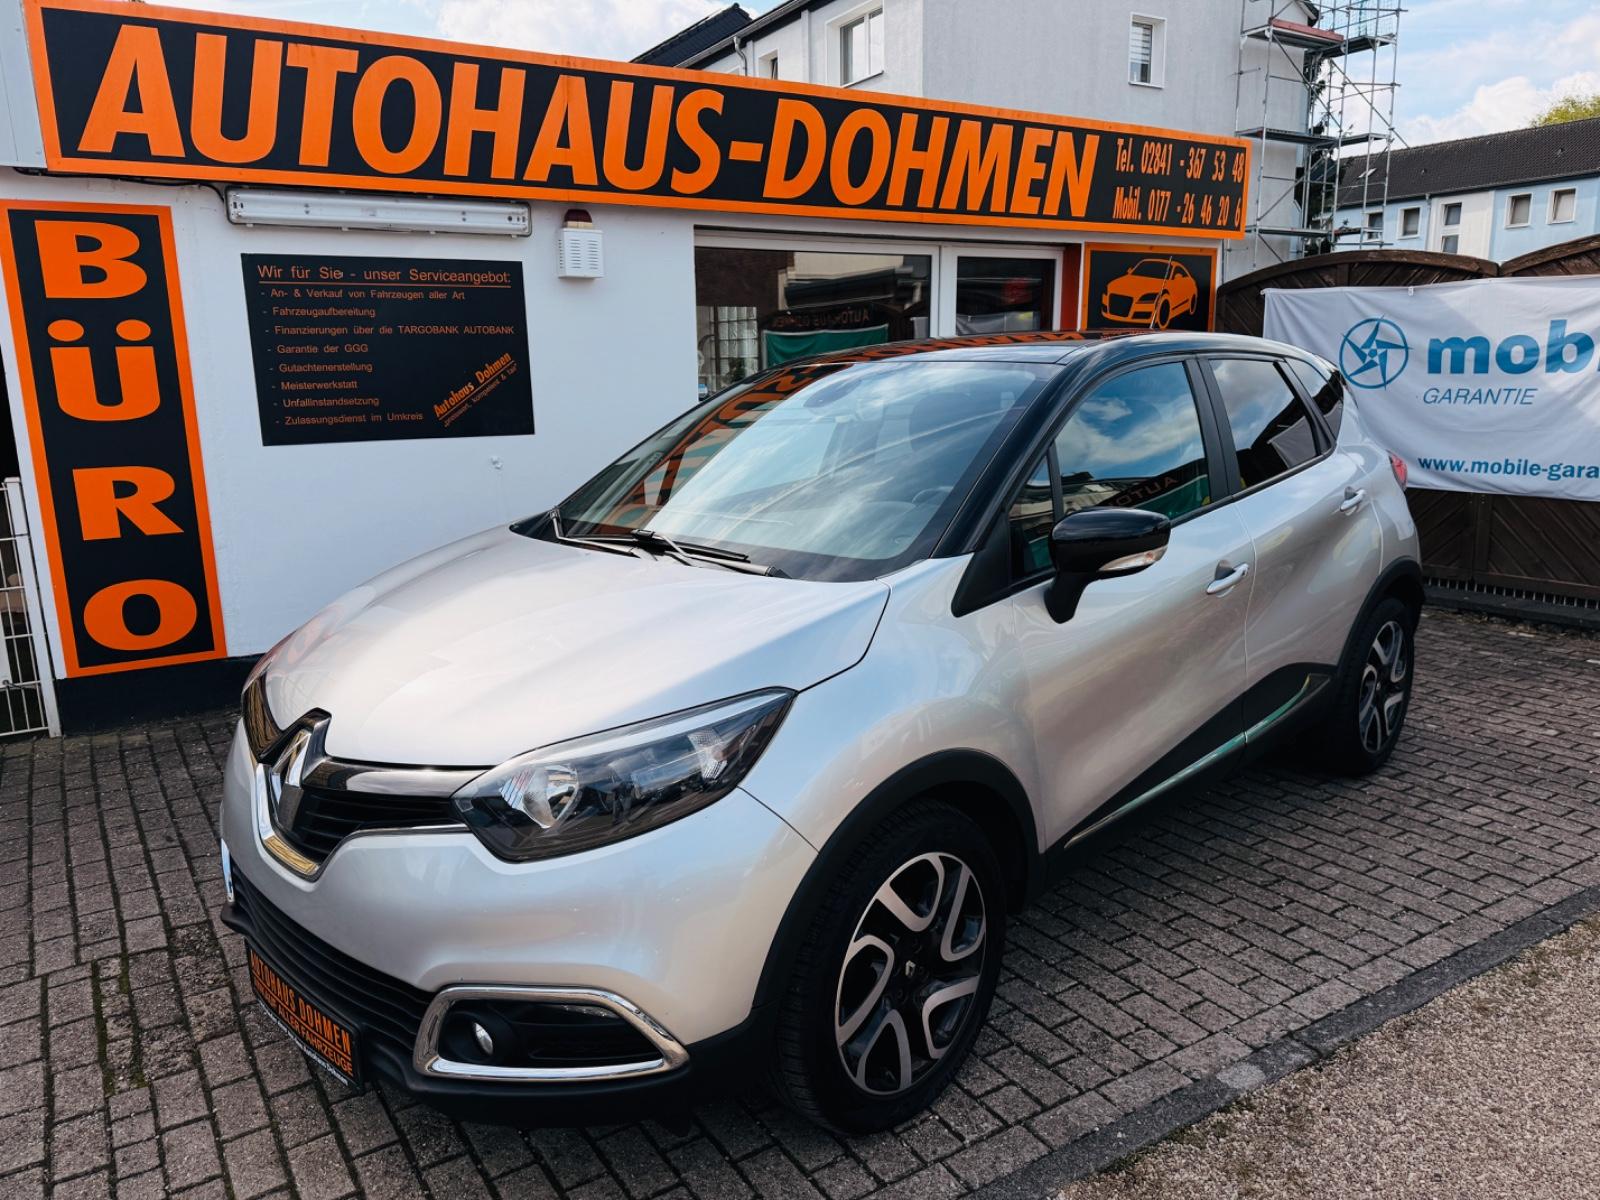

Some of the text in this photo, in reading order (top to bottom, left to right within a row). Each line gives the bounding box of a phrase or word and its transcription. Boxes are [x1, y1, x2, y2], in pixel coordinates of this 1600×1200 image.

[1115, 137, 1135, 173] Tel.
[1141, 140, 1173, 176] 02841
[1211, 150, 1226, 182] 53
[1232, 152, 1245, 183] 48
[1112, 186, 1142, 220] Mobil.
[1147, 188, 1172, 222] 0177
[1200, 194, 1212, 225] 46
[1216, 195, 1230, 226] 20
[1234, 197, 1242, 228] 6
[257, 263, 283, 279] Wir
[291, 265, 311, 279] für
[319, 266, 344, 280] Sie
[363, 268, 401, 281] unser
[409, 268, 512, 286] Serviceangebot:
[270, 288, 466, 301] An- & Verkauf von Fahrzeugen aller Art
[272, 306, 377, 318] Fahrzeugaufbereitung
[274, 325, 515, 337] Finanzierungen über die TARGOBANK AUTOBANK
[276, 343, 370, 354] Garantie der GGG
[1428, 318, 1600, 375] mob
[278, 361, 374, 374] Gutachtenerstellung
[280, 379, 358, 391] Meisterwerkstatt
[433, 381, 475, 418] Autohaus
[474, 352, 512, 384] Dohmen
[282, 397, 381, 408] Unfallinstandsetzung
[1423, 387, 1538, 406] GARANTIE
[284, 411, 424, 427] Zulassungsdienst im Umkreis
[34, 219, 198, 651] BÜRO
[298, 996, 351, 1056] DOHMEN
